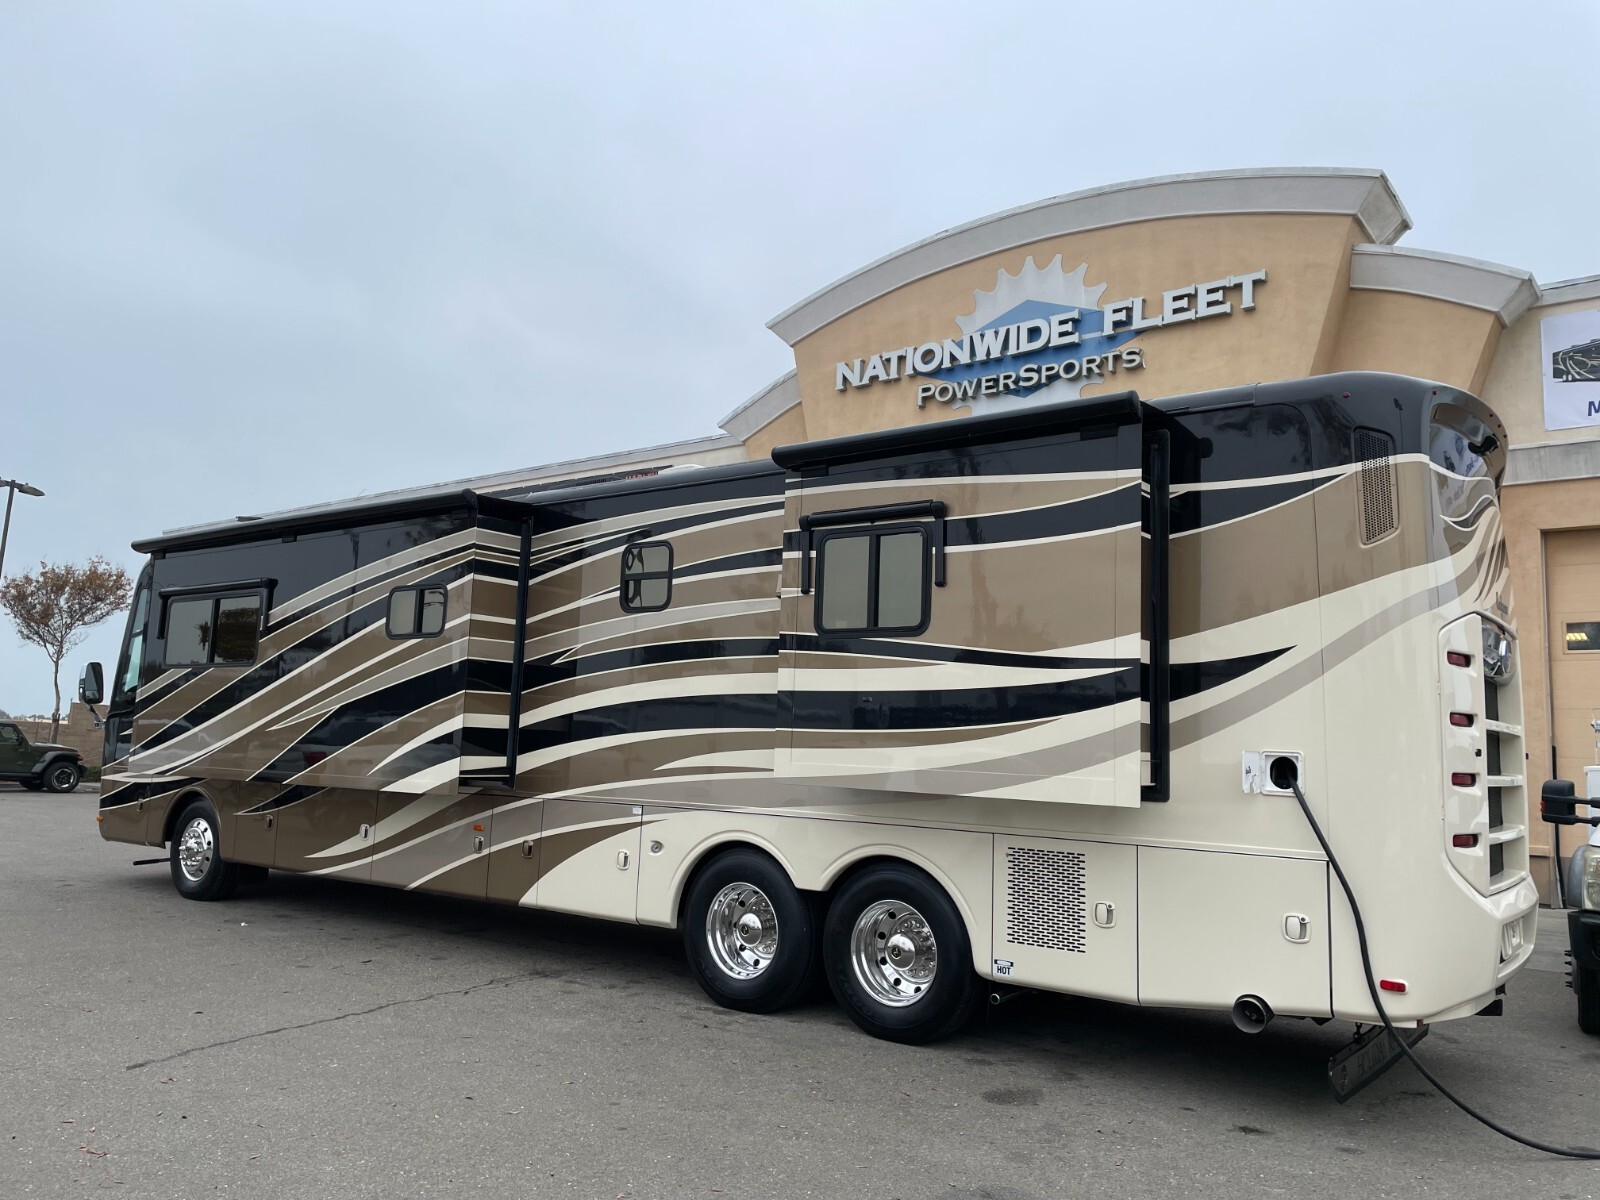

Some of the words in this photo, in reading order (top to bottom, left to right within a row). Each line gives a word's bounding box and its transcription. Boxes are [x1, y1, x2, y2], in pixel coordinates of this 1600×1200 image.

[834, 308, 1081, 391] NATIONWIDE
[1102, 268, 1267, 337] FLEET
[996, 965, 1011, 975] HOT
